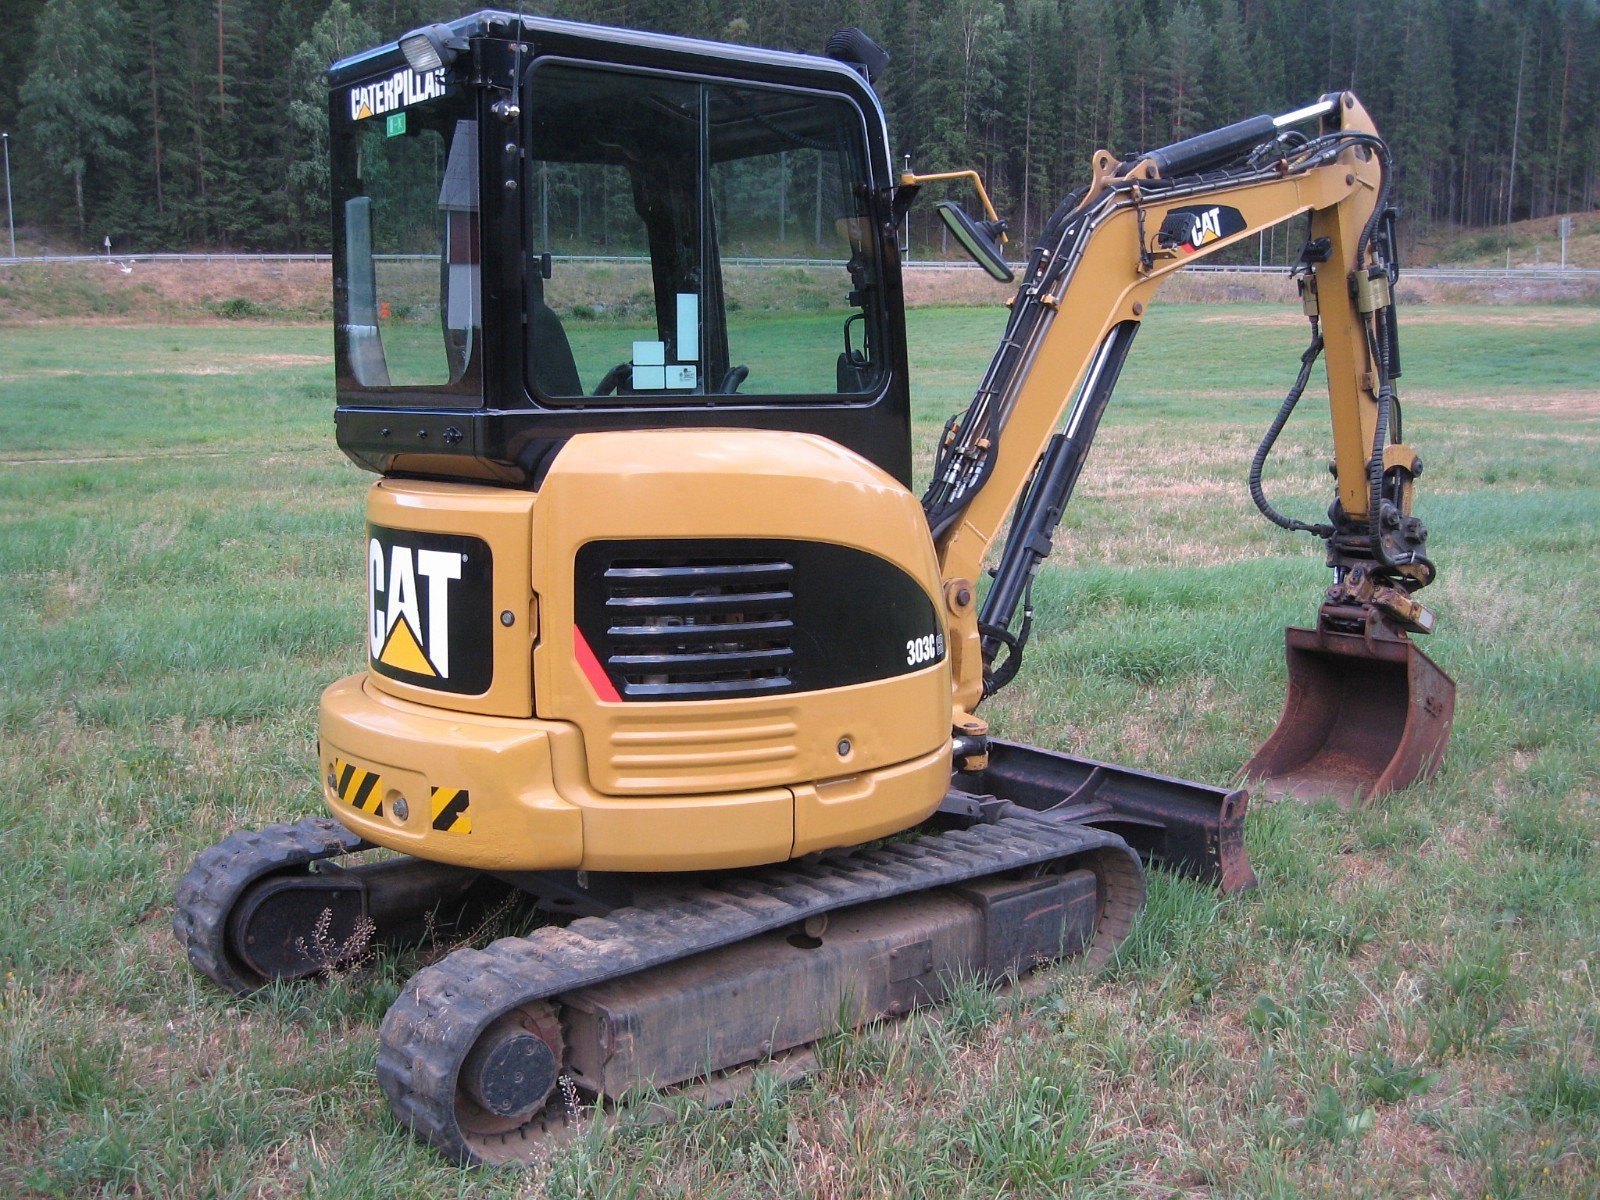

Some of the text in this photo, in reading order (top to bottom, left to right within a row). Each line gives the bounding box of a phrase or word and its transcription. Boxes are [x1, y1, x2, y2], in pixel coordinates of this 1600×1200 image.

[351, 67, 446, 120] CATERPILLAR
[1191, 207, 1221, 247] CAT
[369, 538, 462, 679] CAT
[906, 633, 935, 666] 303C
